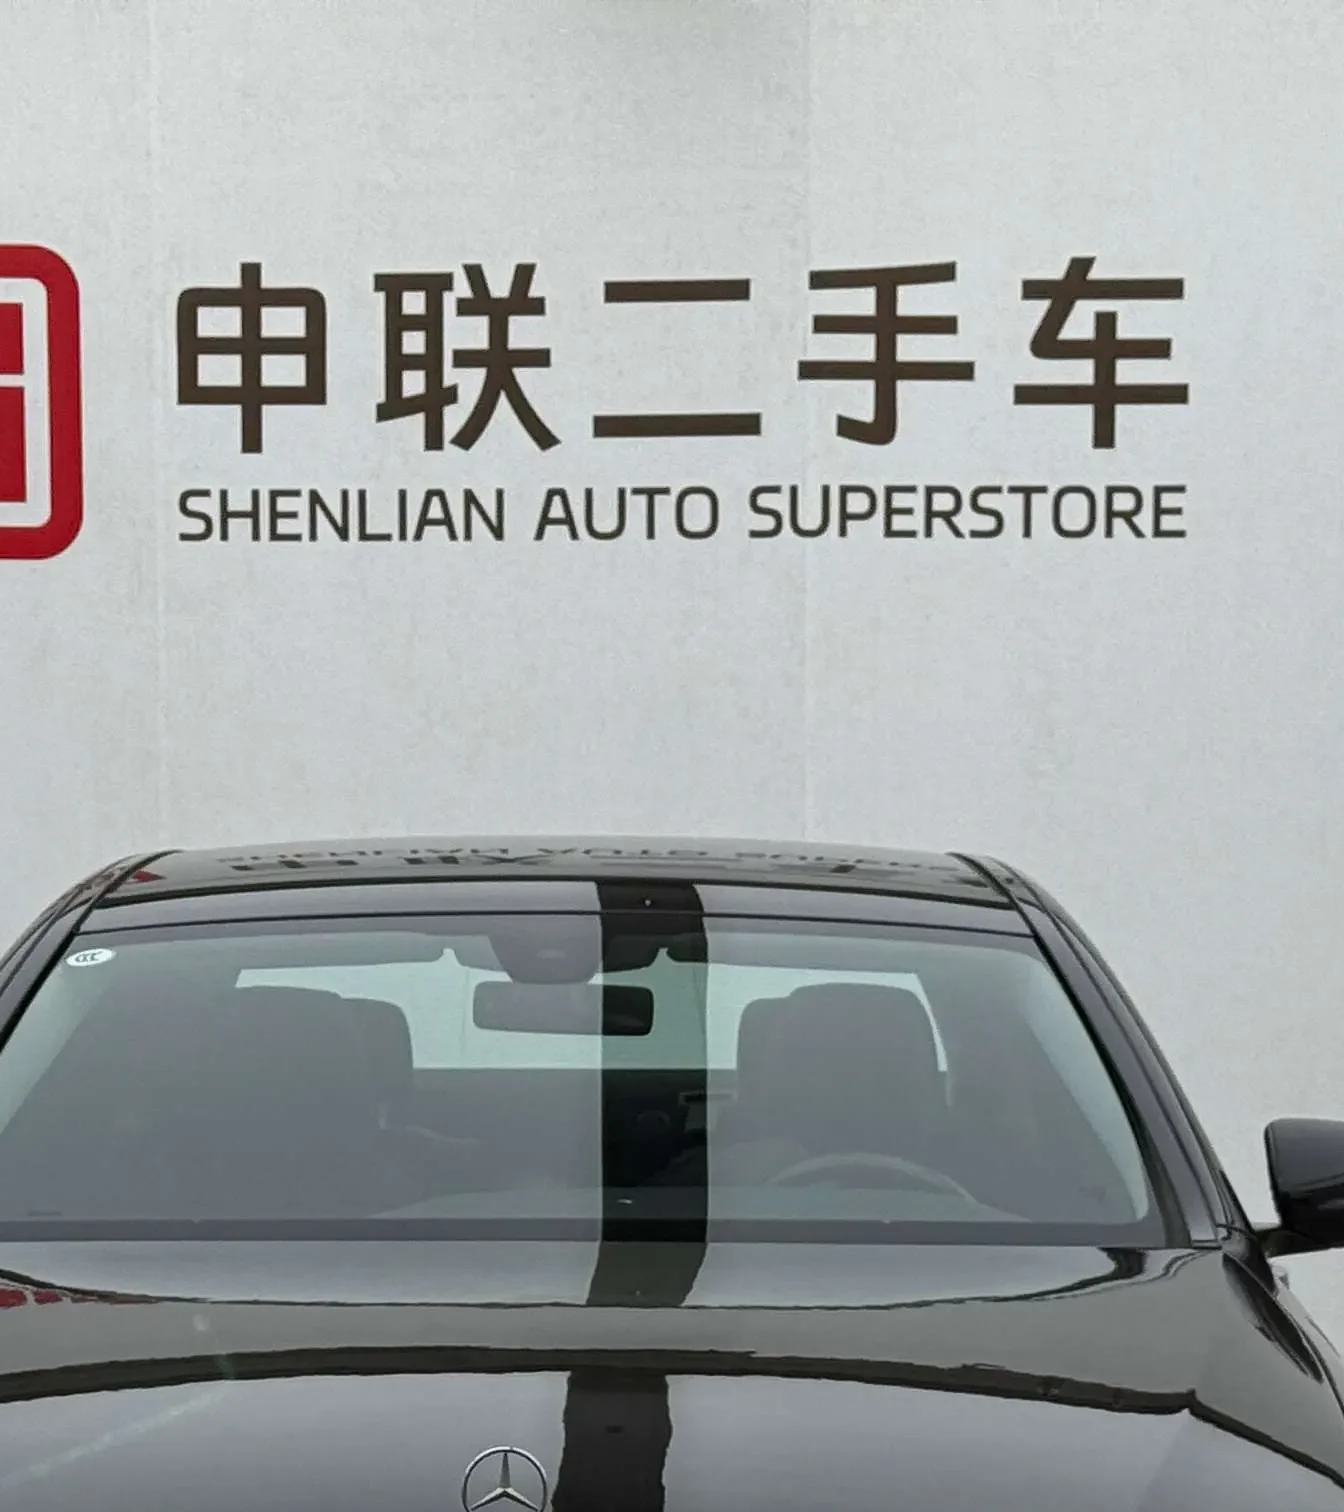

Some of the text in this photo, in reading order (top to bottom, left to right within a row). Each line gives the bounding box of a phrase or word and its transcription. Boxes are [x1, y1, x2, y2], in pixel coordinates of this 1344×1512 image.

[175, 255, 1189, 454] 申联二手车
[177, 484, 1187, 542] SHENLIAN AUTO SUPERSTORE
